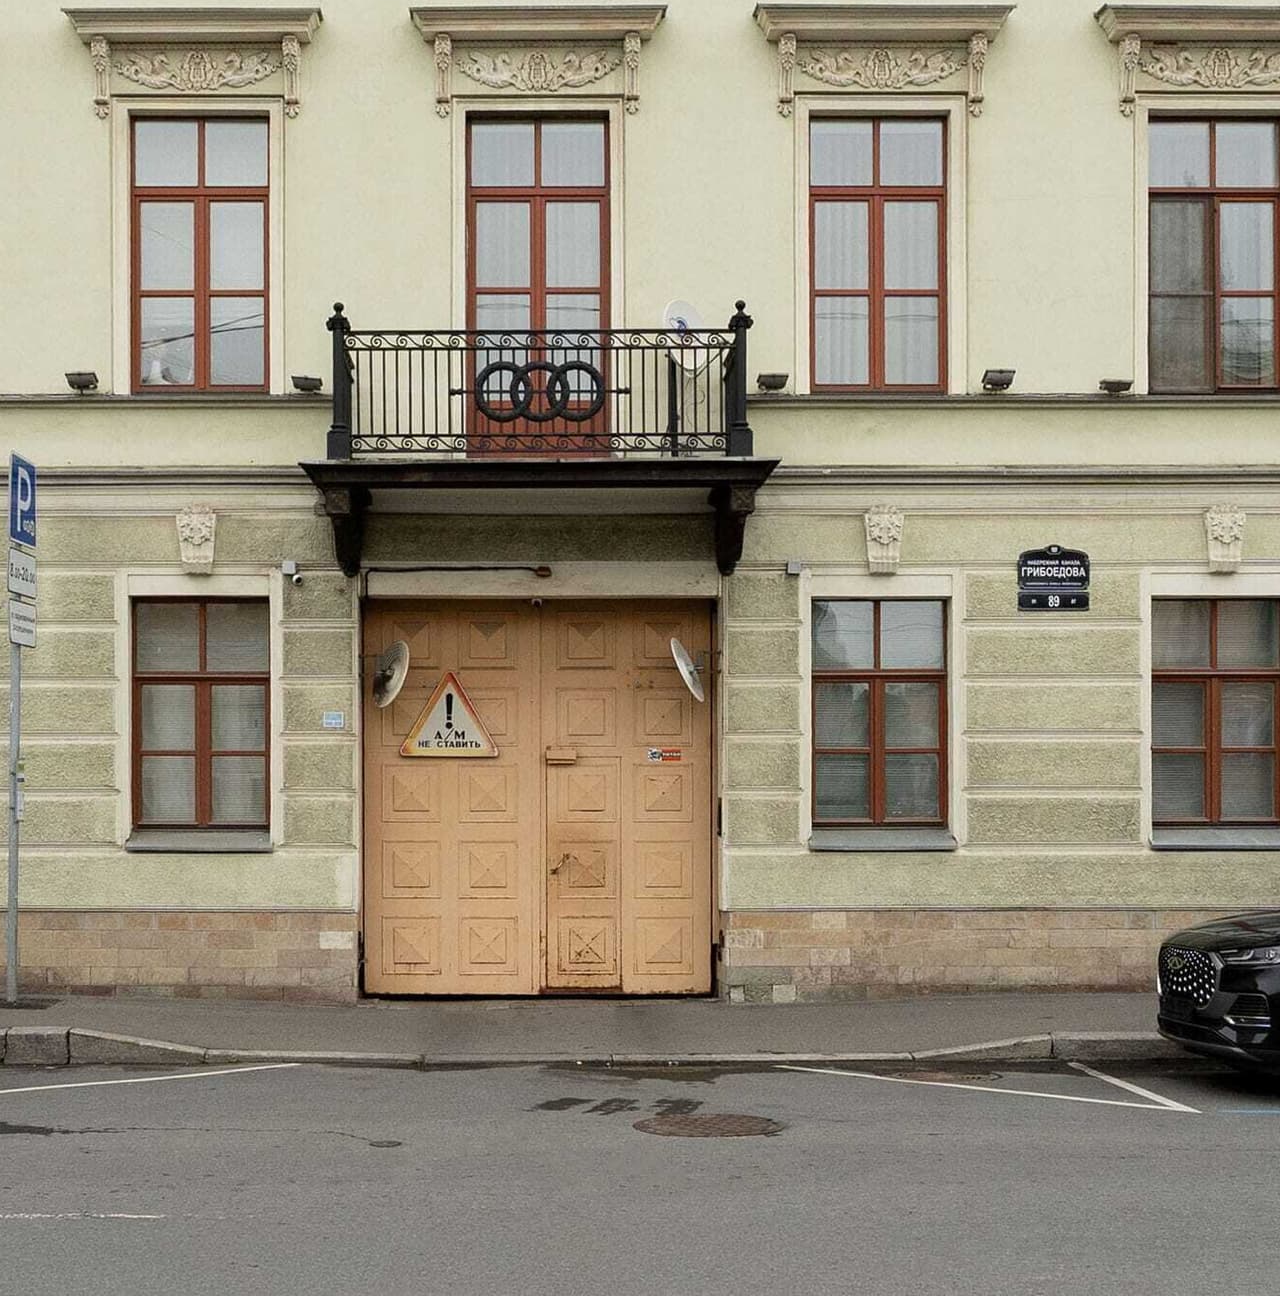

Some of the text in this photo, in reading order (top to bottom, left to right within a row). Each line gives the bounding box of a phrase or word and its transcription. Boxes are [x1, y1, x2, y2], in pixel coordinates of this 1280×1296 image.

[17, 466, 32, 532] P
[1021, 567, 1086, 578] ГРИБОЕДОВА
[1048, 595, 1060, 607] 89
